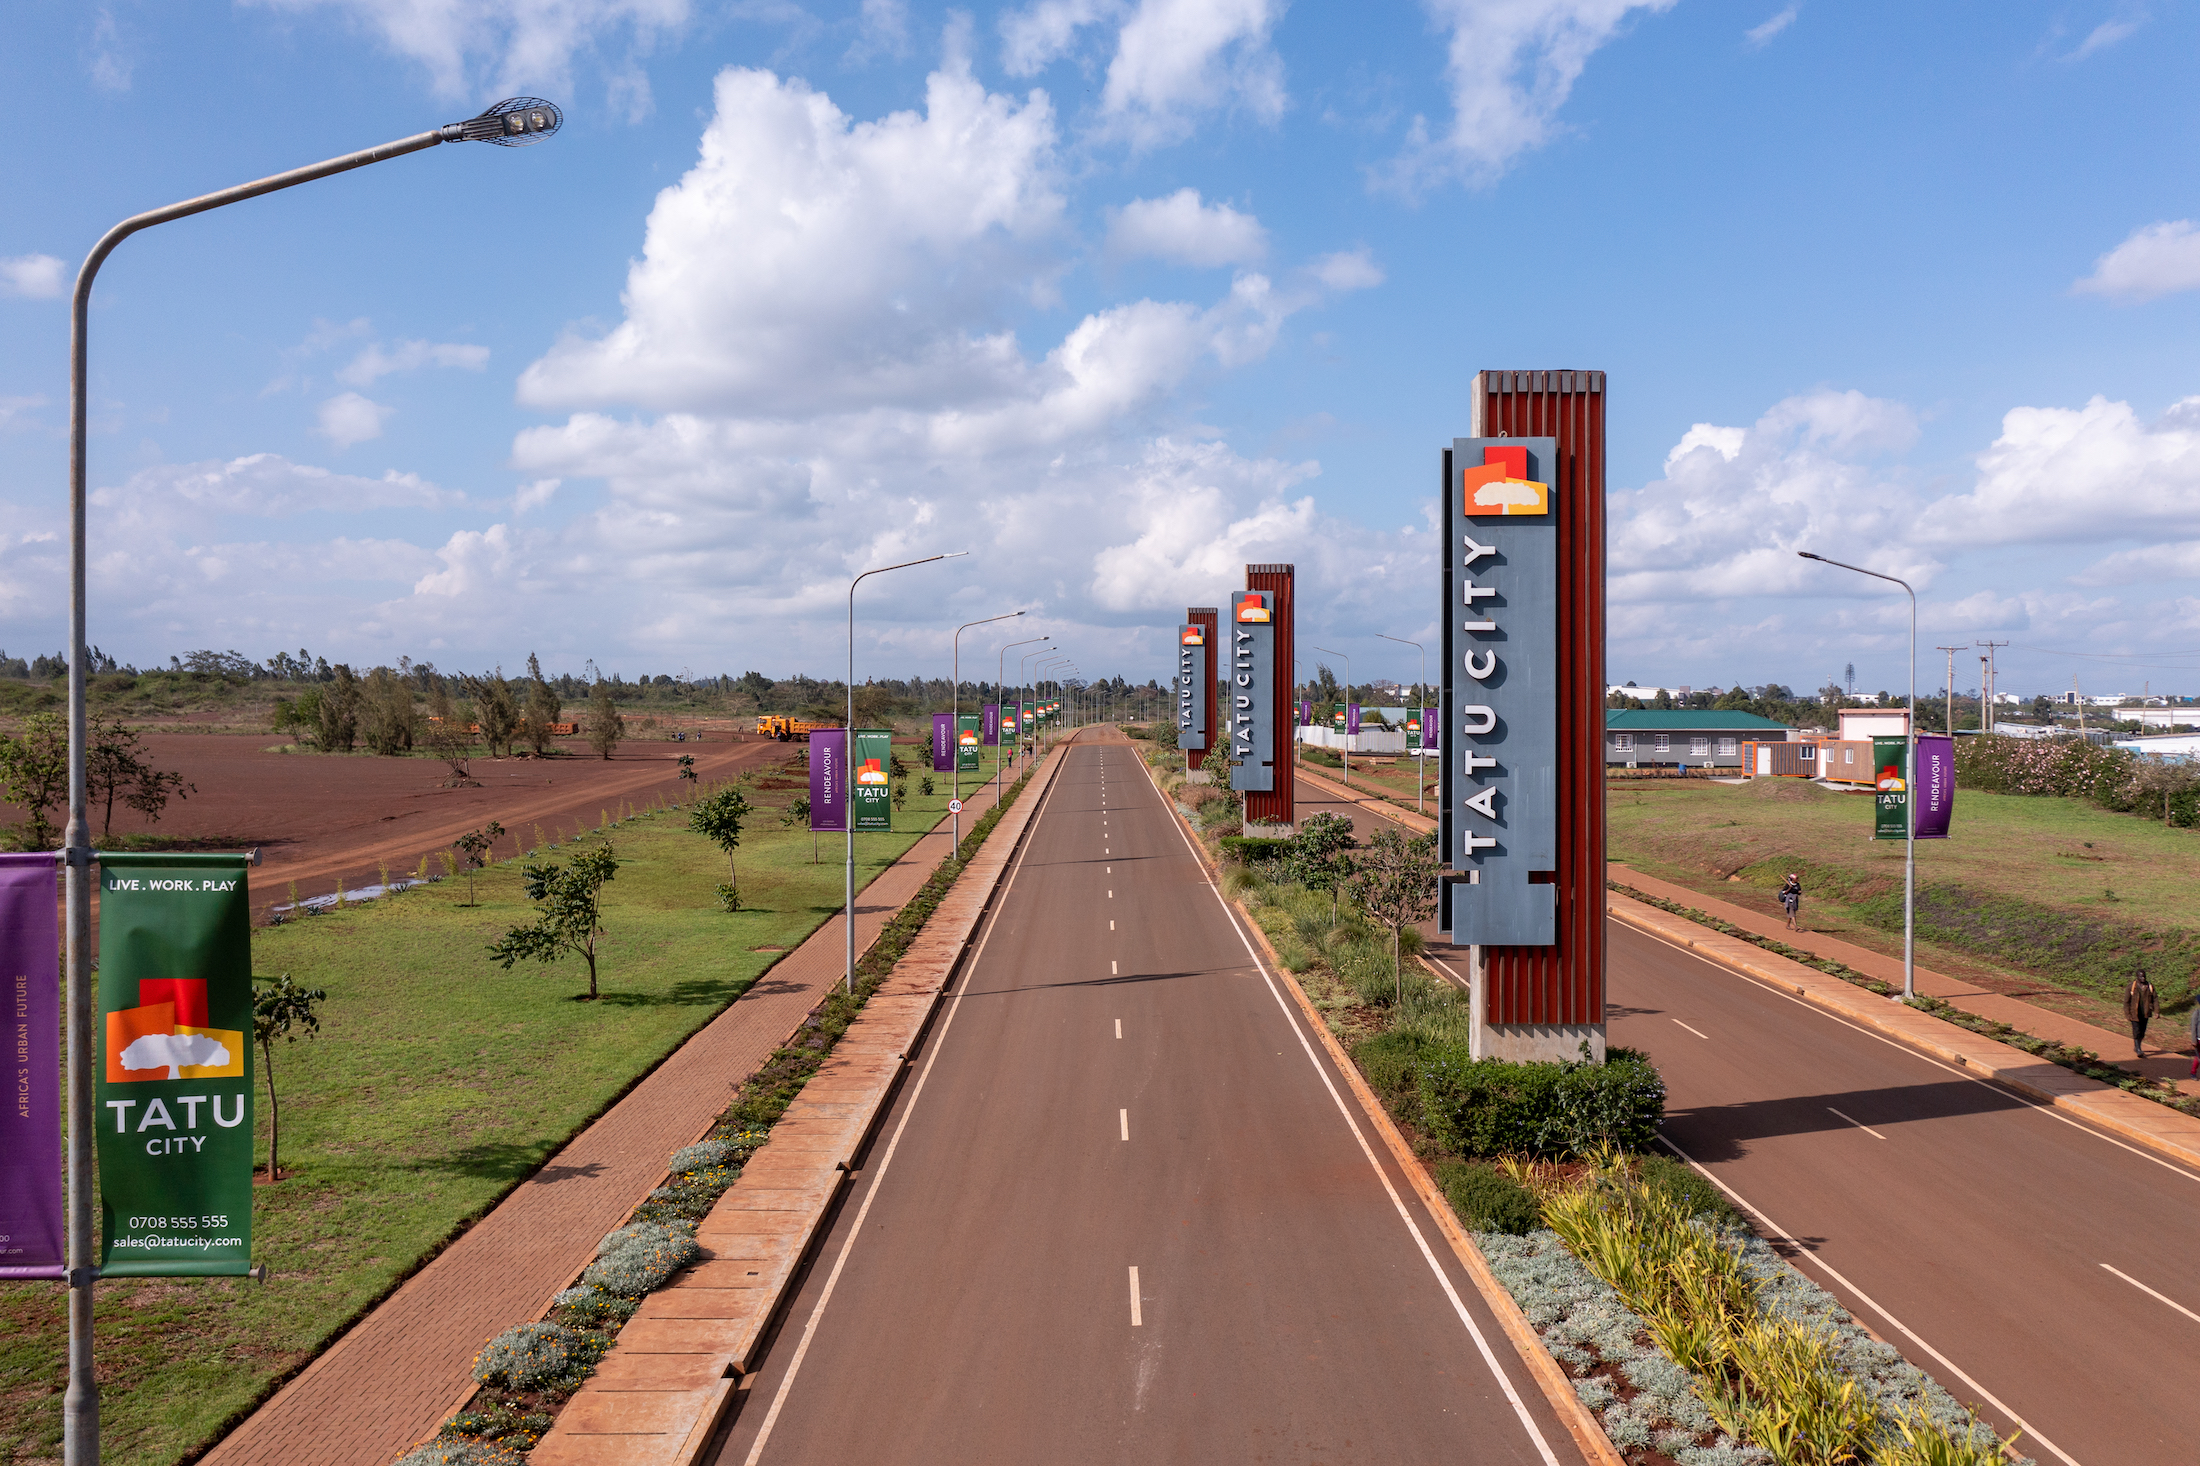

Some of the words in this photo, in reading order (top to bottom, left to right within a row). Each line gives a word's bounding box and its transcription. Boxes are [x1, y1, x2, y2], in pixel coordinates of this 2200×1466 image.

[1463, 535, 1497, 680] CITY
[1181, 648, 1191, 685] CITY
[1236, 629, 1250, 687] CITY
[1181, 690, 1191, 728] TATU
[1236, 695, 1250, 756] TATU
[823, 747, 832, 804] RENDEAVOUR
[856, 788, 889, 797] TATU
[1464, 704, 1497, 855] TATU
[1930, 754, 1940, 812] RENDEAVOUR
[950, 802, 961, 810] 40
[1877, 794, 1906, 804] TATU
[109, 879, 140, 891] LIVE
[149, 879, 194, 891] WORK
[202, 880, 237, 892] PLAY
[16, 974, 28, 1018] FUTURE
[17, 1024, 29, 1063] URBAN
[18, 1067, 30, 1118] AFRICA'S
[106, 1093, 245, 1134] TATU
[145, 1135, 207, 1156] CITY
[129, 1216, 168, 1229] 0708
[170, 1216, 198, 1229] 555
[201, 1215, 229, 1229] 555
[113, 1233, 243, 1251] sales@tatucity.com
